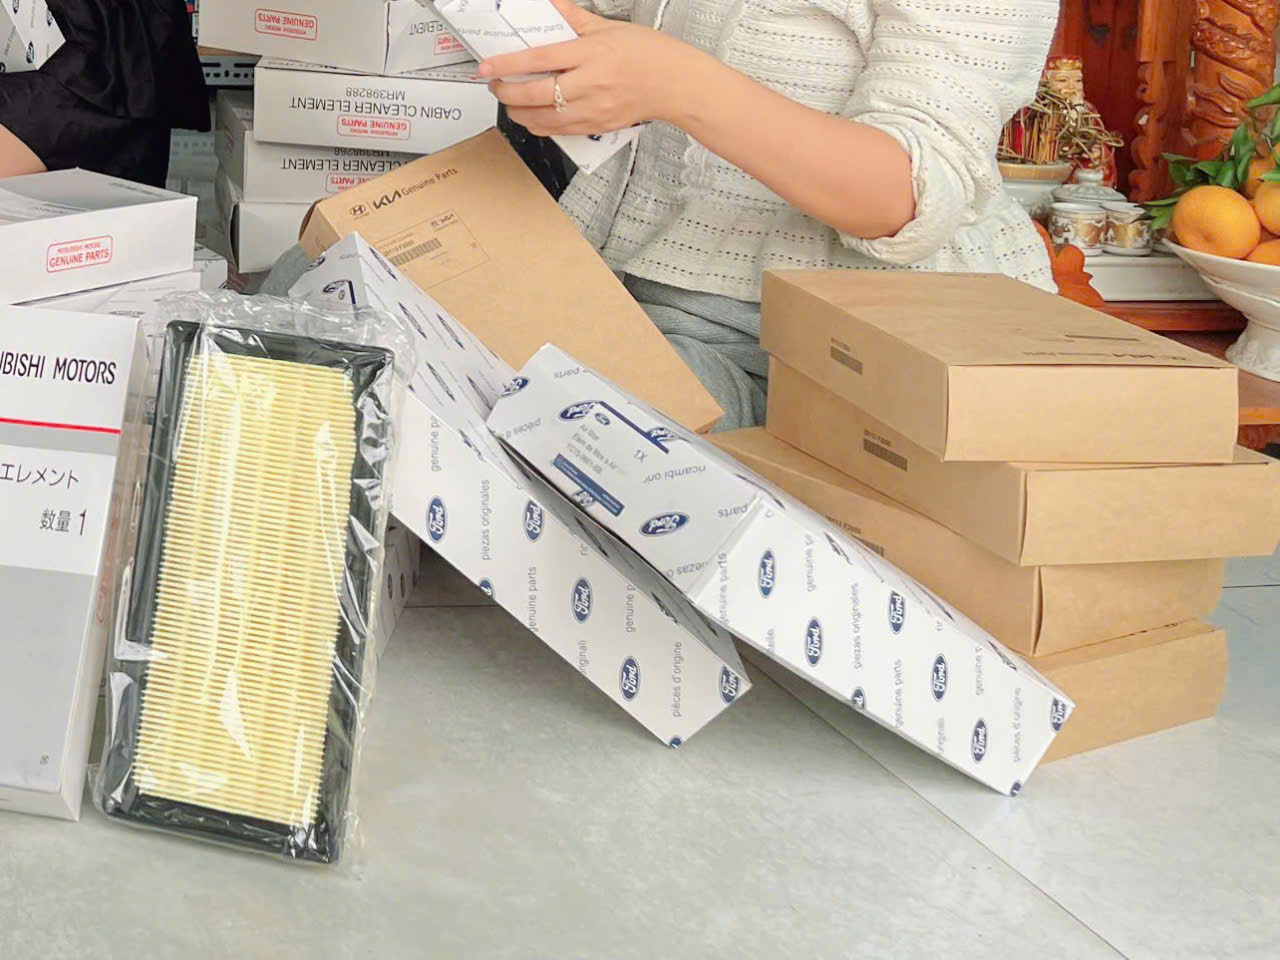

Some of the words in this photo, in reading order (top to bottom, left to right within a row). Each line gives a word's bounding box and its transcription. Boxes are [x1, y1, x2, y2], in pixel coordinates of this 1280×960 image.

[258, 13, 281, 24] PARTS
[283, 17, 315, 28] GENUINE
[289, 96, 350, 112] ELEMENT
[345, 86, 405, 100] MR398288
[341, 119, 368, 128] PARTS
[355, 101, 417, 117] CLEANER
[421, 106, 461, 120] CABIN
[370, 121, 407, 131] GENUINE
[280, 158, 338, 171] ELEMENT
[373, 190, 402, 209] KIA
[401, 177, 436, 196] Genuine
[435, 168, 458, 181] Parts
[49, 253, 84, 268] GENUINE
[85, 248, 110, 263] PARTS
[53, 357, 117, 385] MOTORS
[429, 431, 440, 471] genuine
[672, 464, 706, 480] ricambi
[479, 479, 490, 526] originales
[718, 504, 748, 518] parts
[40, 509, 71, 533] 数量
[426, 497, 446, 540] Ford
[523, 500, 543, 541] Ford
[640, 512, 689, 536] Ford
[480, 529, 490, 559] piezas
[526, 566, 538, 591] parts
[758, 550, 774, 597] Ford
[804, 548, 816, 591] genuine
[527, 594, 538, 631] genuine
[571, 578, 592, 622] Ford
[624, 595, 636, 631] genuine
[889, 590, 905, 633] Ford
[804, 618, 822, 665] Ford
[850, 635, 862, 668] piezas
[619, 657, 639, 700] Ford
[930, 654, 947, 700] Ford
[971, 719, 987, 762] Ford
